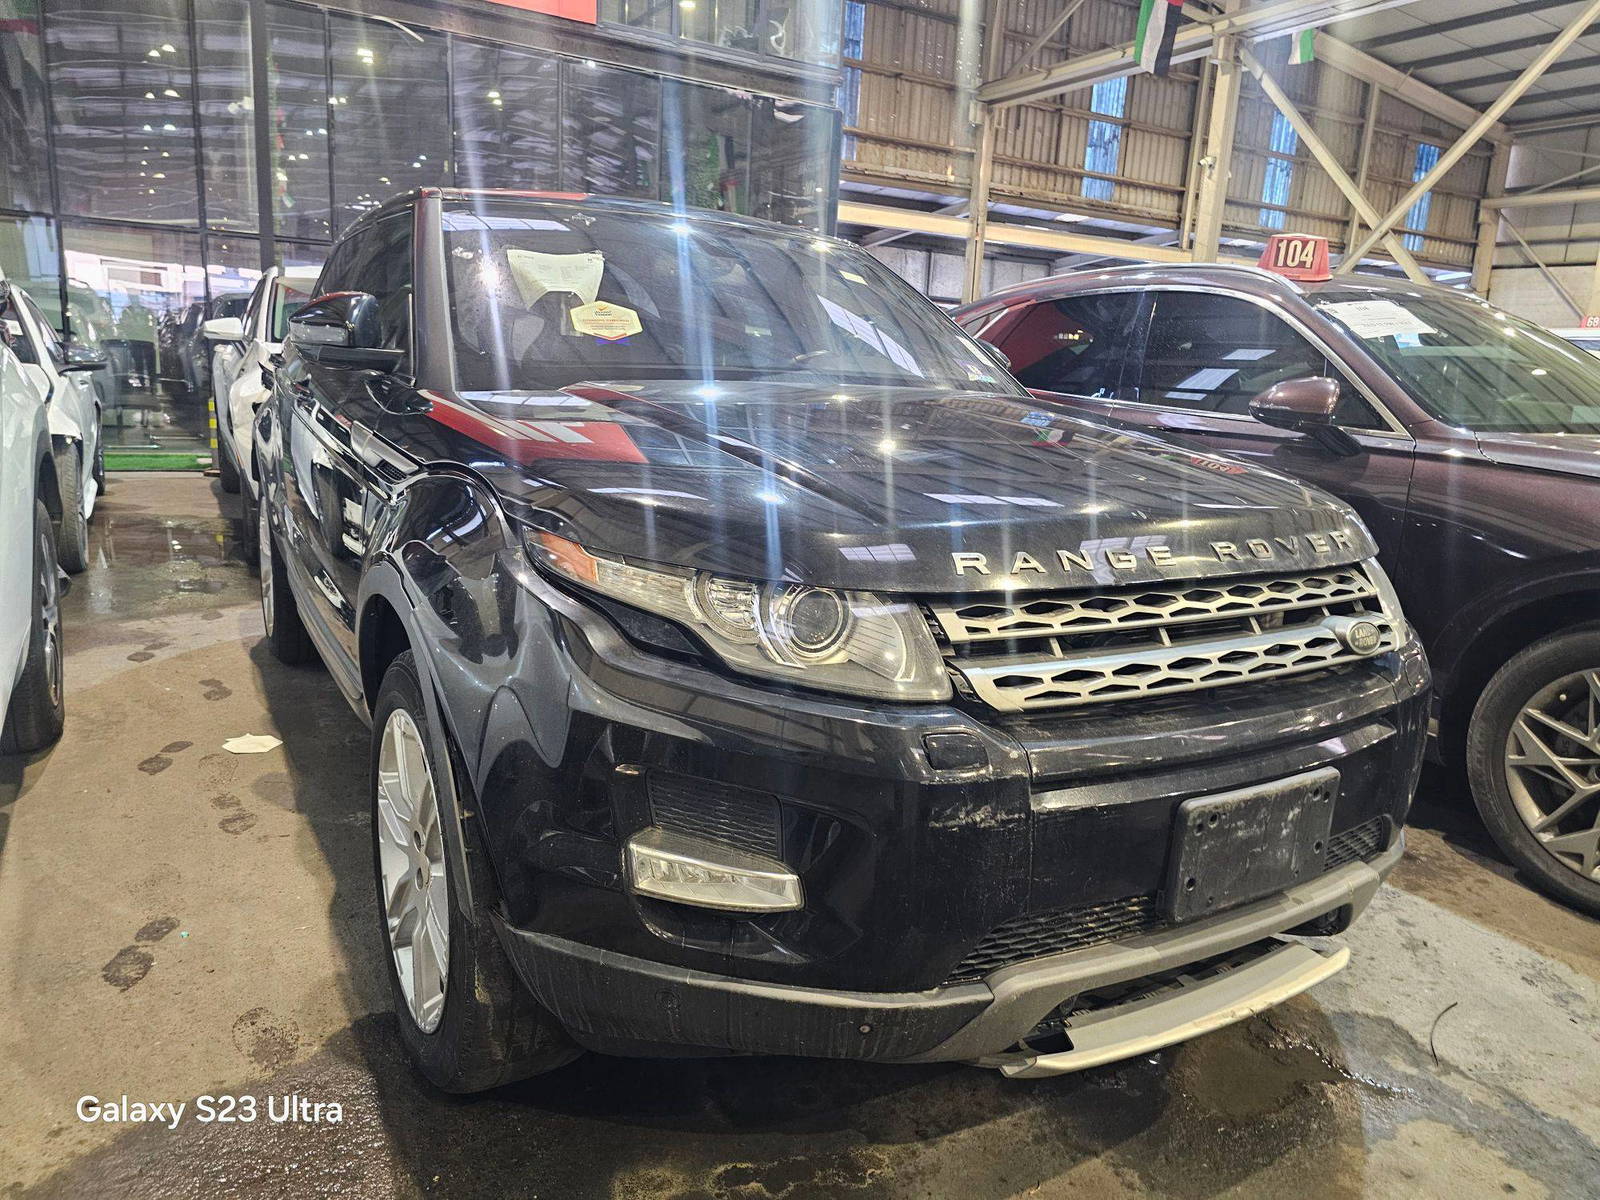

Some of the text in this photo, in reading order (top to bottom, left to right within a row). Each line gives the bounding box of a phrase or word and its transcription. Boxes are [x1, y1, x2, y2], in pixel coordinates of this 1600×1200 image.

[1276, 239, 1316, 269] 104
[951, 529, 1353, 575] RANGE ROVER
